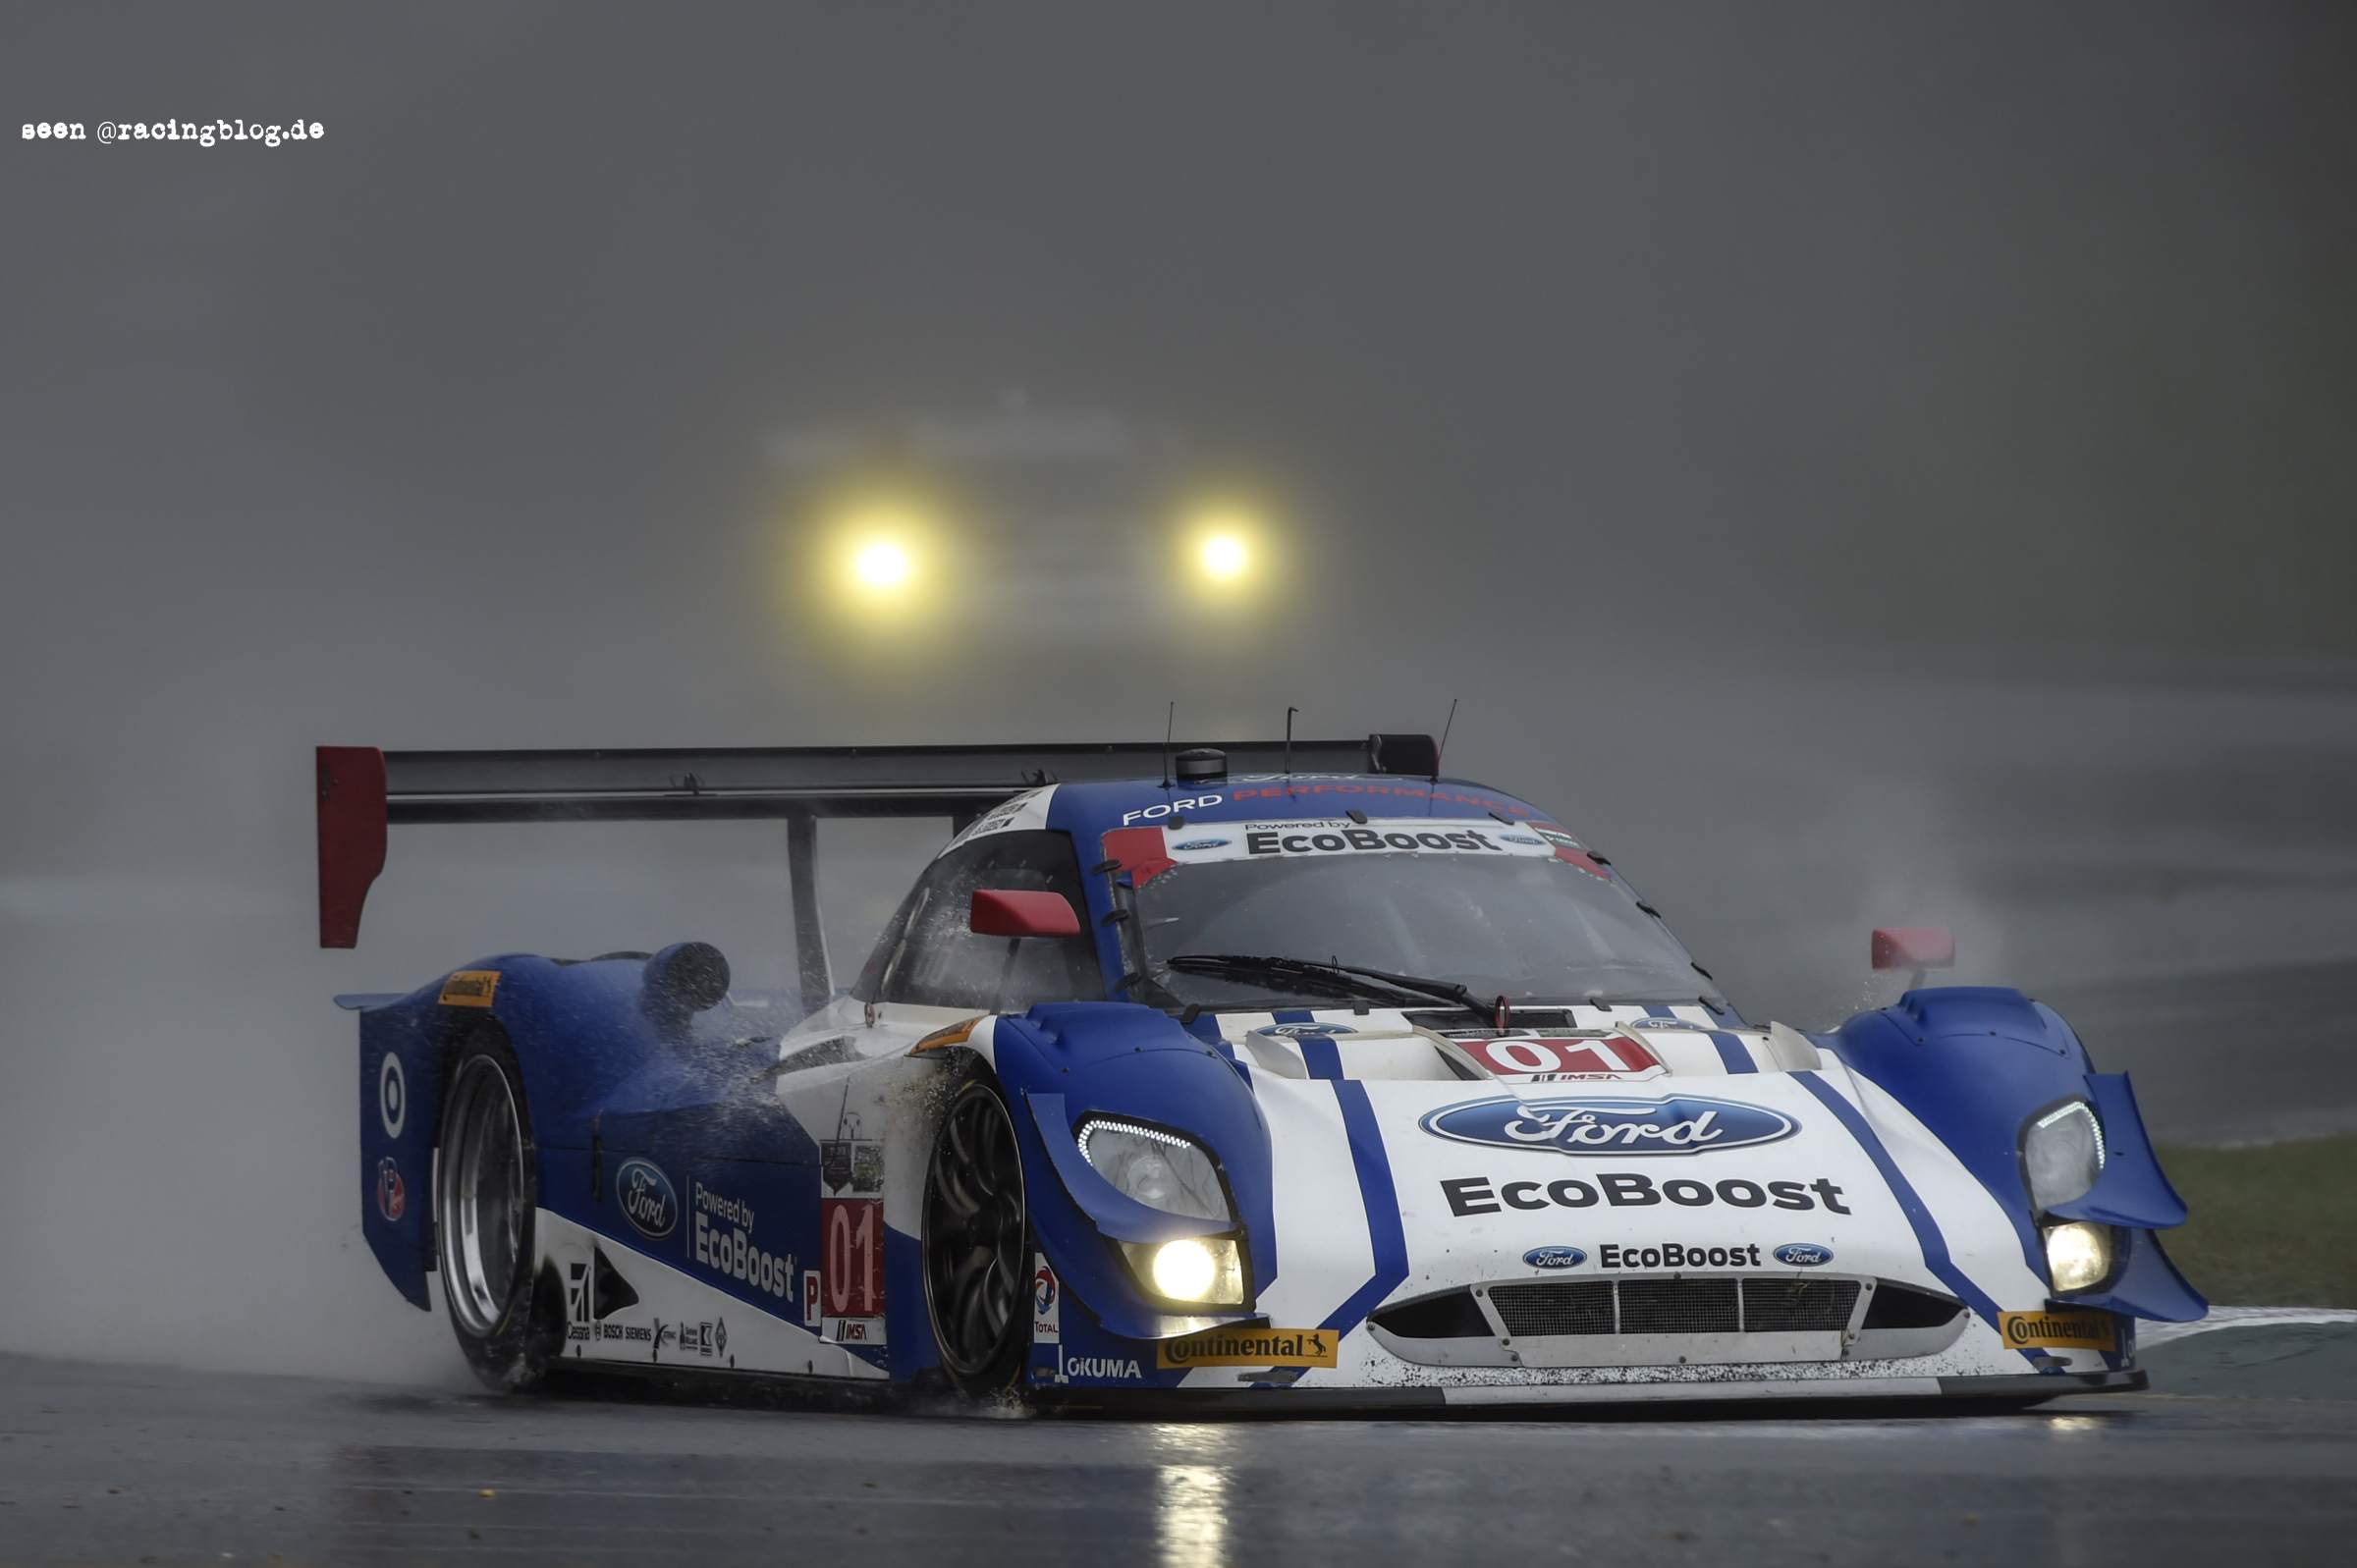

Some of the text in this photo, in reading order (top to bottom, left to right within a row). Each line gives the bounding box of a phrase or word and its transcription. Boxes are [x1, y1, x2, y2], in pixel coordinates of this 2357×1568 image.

[1123, 784, 1530, 826] FORD PERFORMANCE
[1245, 821, 1324, 830] Powered
[1246, 829, 1502, 854] EcoBoost
[1485, 1040, 1630, 1072] 01
[1505, 1105, 1724, 1146] Ford
[628, 1168, 667, 1227] Ford
[695, 1181, 754, 1234] Powered by
[1440, 1173, 1851, 1217] EcoBoost
[695, 1211, 794, 1303] EcoBoost
[830, 1204, 874, 1313] 01
[1536, 1250, 1575, 1266] Ford
[1599, 1243, 1761, 1269] EcoBoost
[1784, 1247, 1823, 1264] Ford
[806, 1275, 818, 1321] P
[603, 1324, 624, 1339] BOSCH
[625, 1326, 652, 1342] SIEMENS
[1165, 1333, 1304, 1365] Continental
[1067, 1357, 1143, 1379] OKUMA
